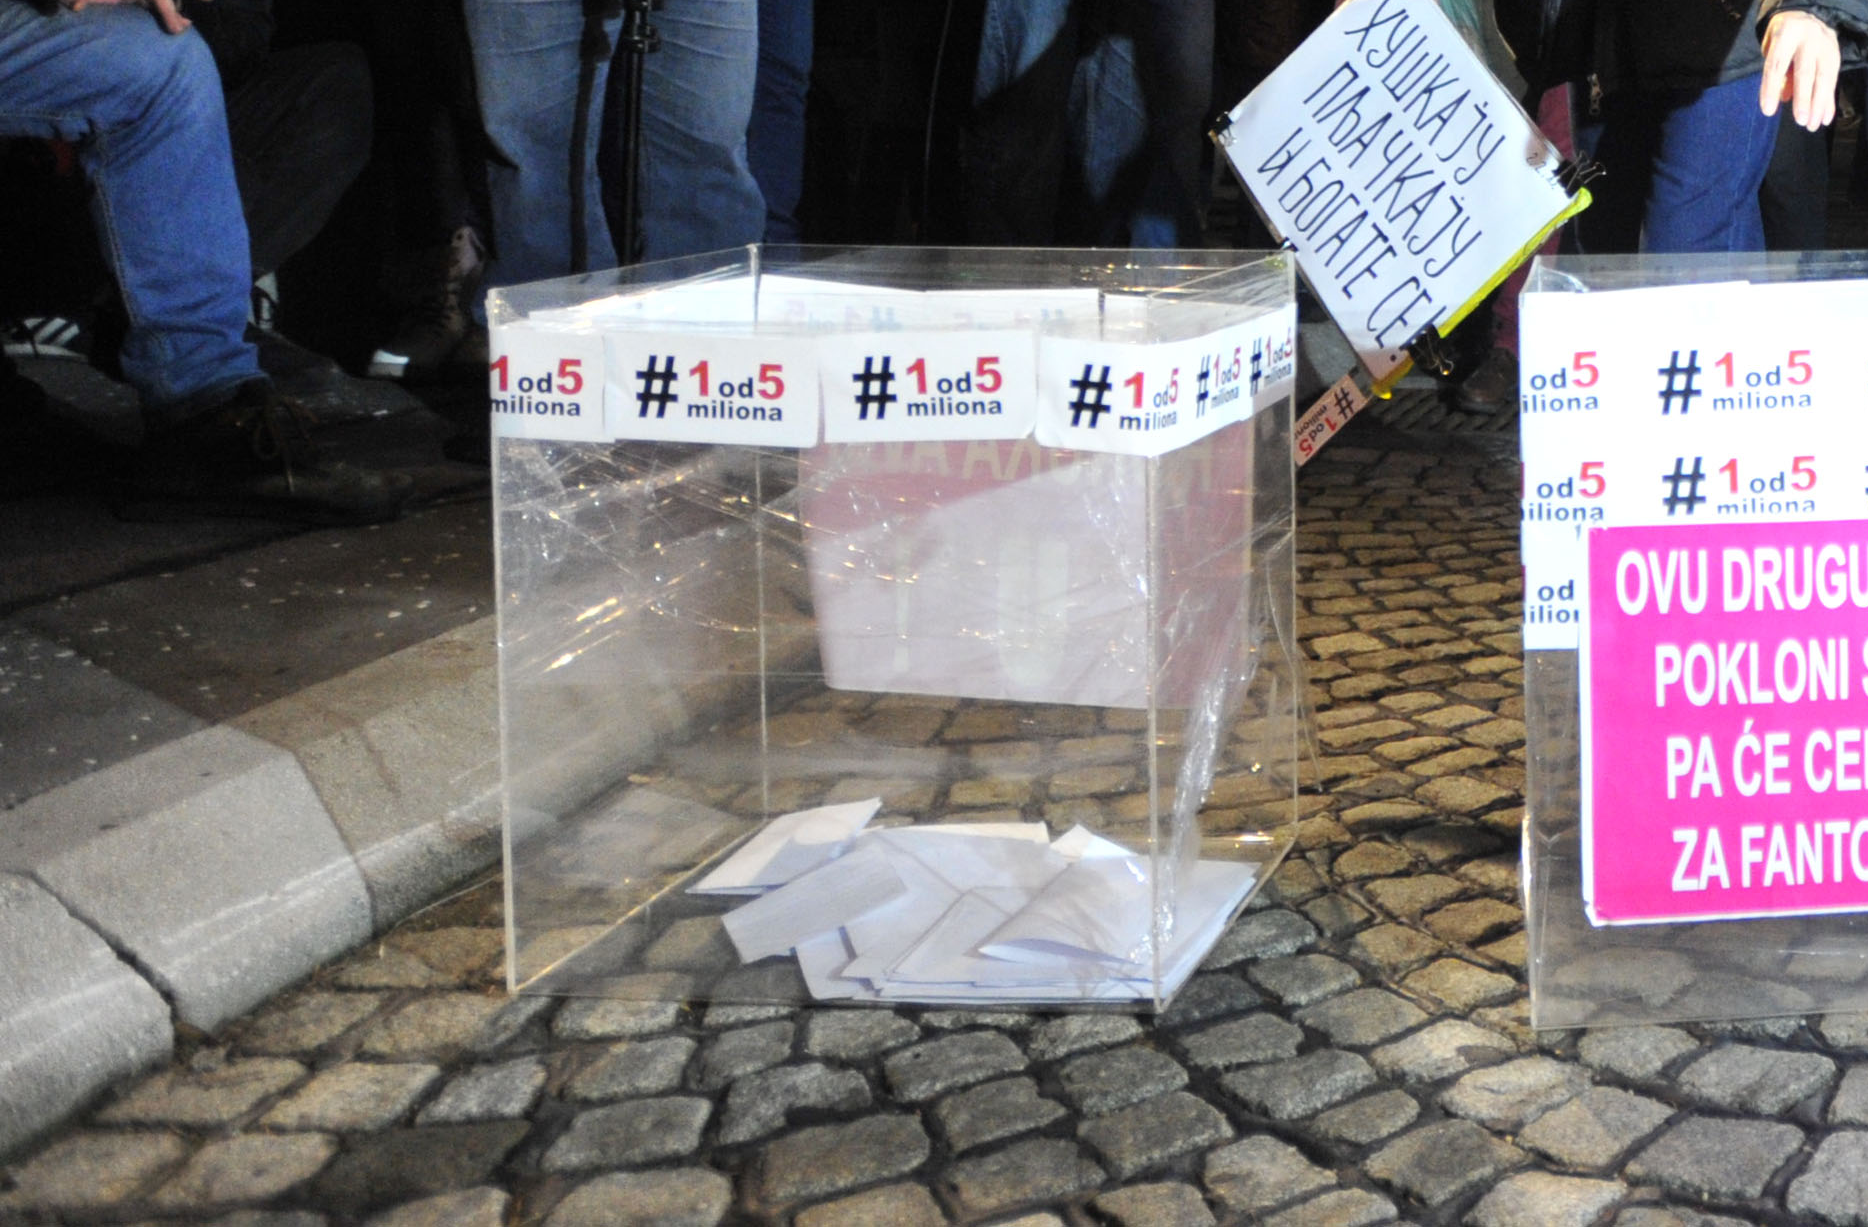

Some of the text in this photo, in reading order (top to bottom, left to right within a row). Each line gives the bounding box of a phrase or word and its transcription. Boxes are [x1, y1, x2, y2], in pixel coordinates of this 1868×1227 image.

[1257, 127, 1304, 187] И
[1302, 61, 1483, 279] ПЉАЧКАЈУ
[1278, 157, 1398, 300] БОГАТЕ
[687, 400, 783, 422] miliona
[907, 397, 1002, 417] miliona
[1119, 410, 1178, 431] miliona
[1521, 392, 1599, 413] iliona
[1713, 392, 1812, 411] miliona
[1717, 497, 1815, 515] miliona
[1616, 549, 1708, 616] OVU
[1655, 637, 1848, 707] POKLONI
[1666, 735, 1722, 799] PA
[1733, 719, 1789, 797] ĆE
[1672, 827, 1730, 891] ZA
